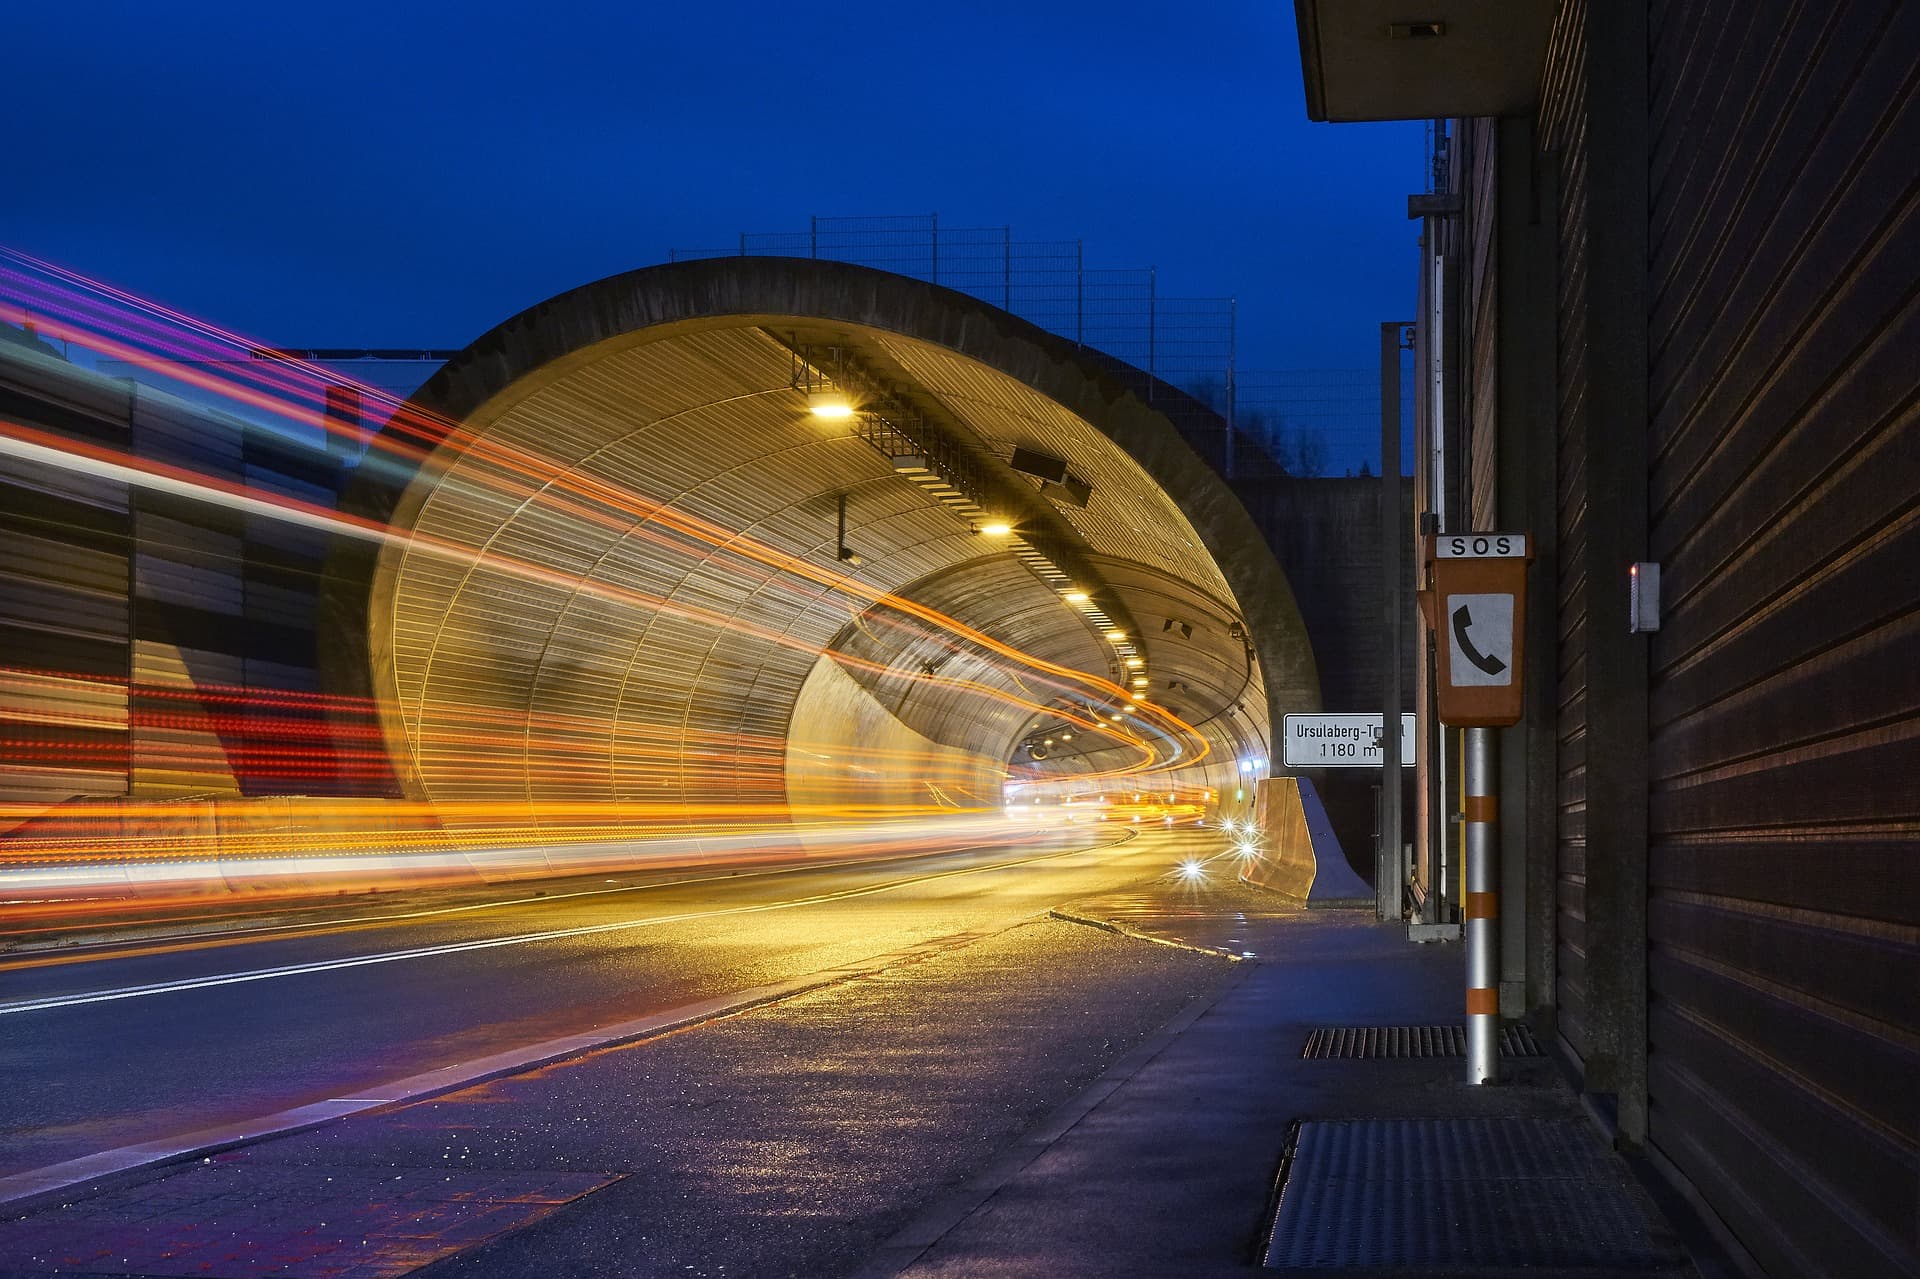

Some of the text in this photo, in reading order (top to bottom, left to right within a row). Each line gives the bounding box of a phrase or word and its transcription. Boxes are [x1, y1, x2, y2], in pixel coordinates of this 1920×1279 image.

[1451, 537, 1511, 556] SOS
[1296, 723, 1406, 741] Ursulaberg-Tl
[1321, 743, 1377, 757] 1180 m
